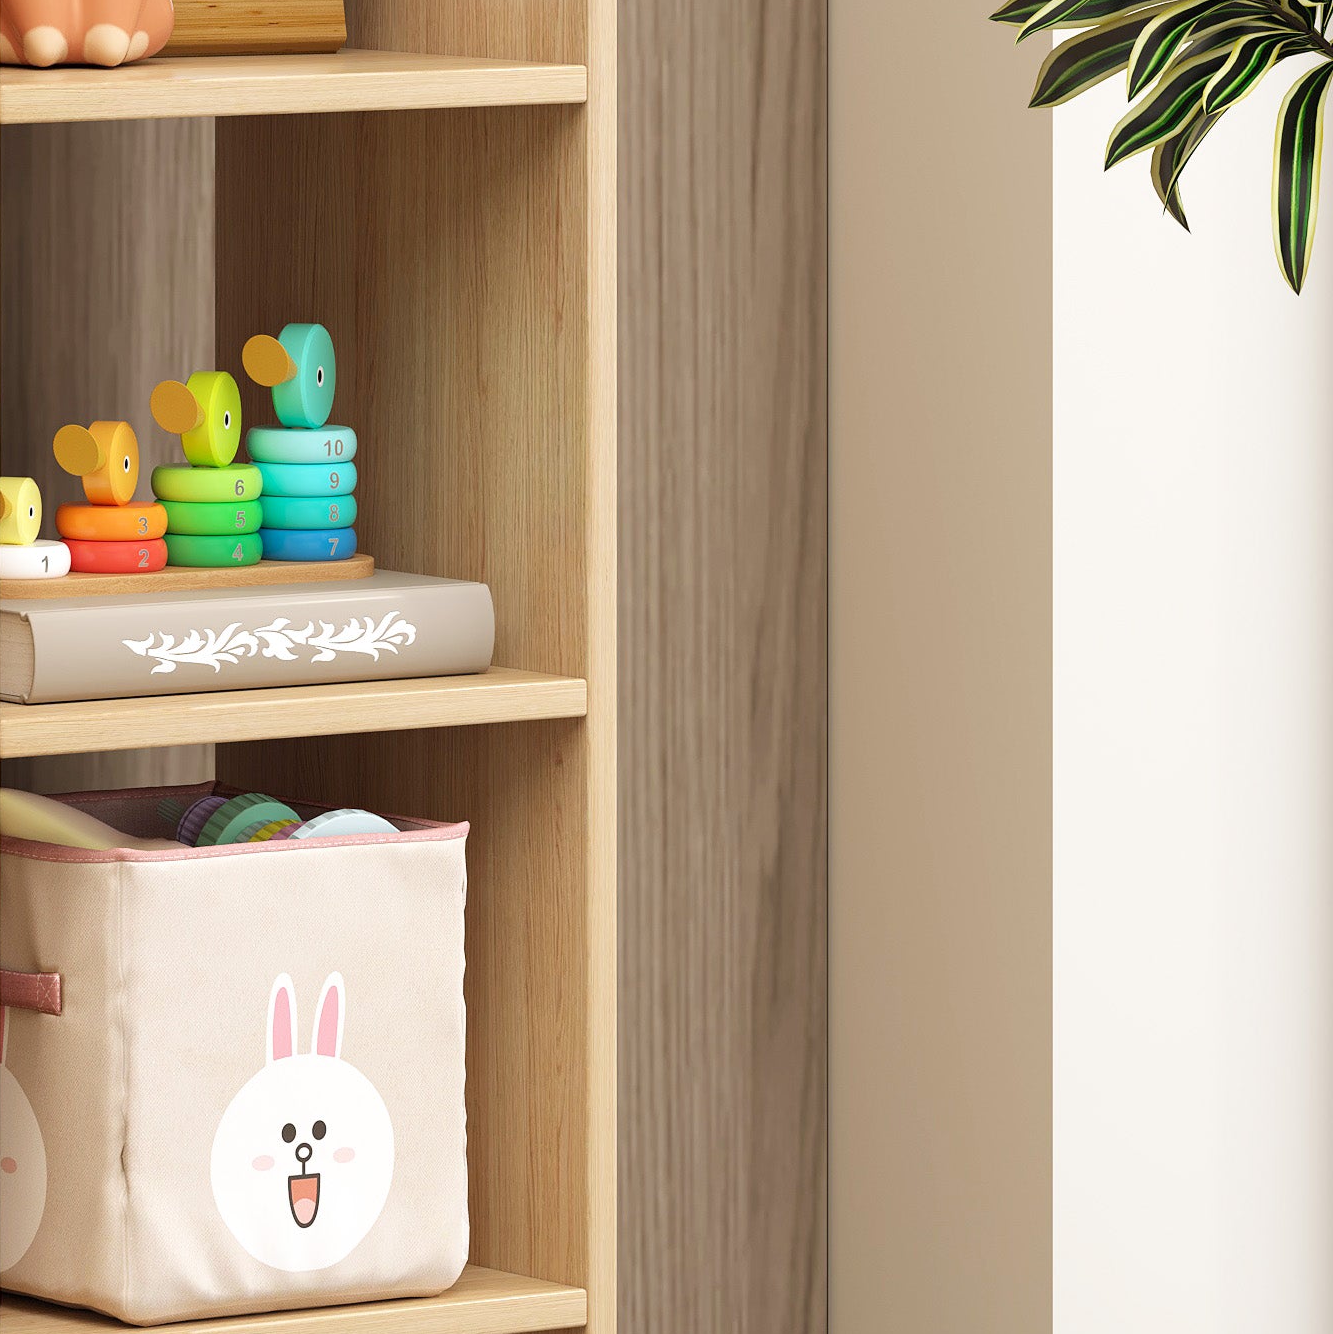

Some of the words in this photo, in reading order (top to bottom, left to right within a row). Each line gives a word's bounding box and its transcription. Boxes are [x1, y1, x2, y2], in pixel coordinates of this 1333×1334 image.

[323, 439, 344, 457] 10
[234, 480, 245, 497] 6
[329, 472, 340, 489] 9
[235, 511, 246, 528] 5
[329, 505, 339, 522] 8
[138, 518, 148, 534] 3
[232, 544, 244, 561] 4
[328, 538, 340, 556] 7
[41, 555, 49, 573] 1
[138, 550, 149, 567] 2
